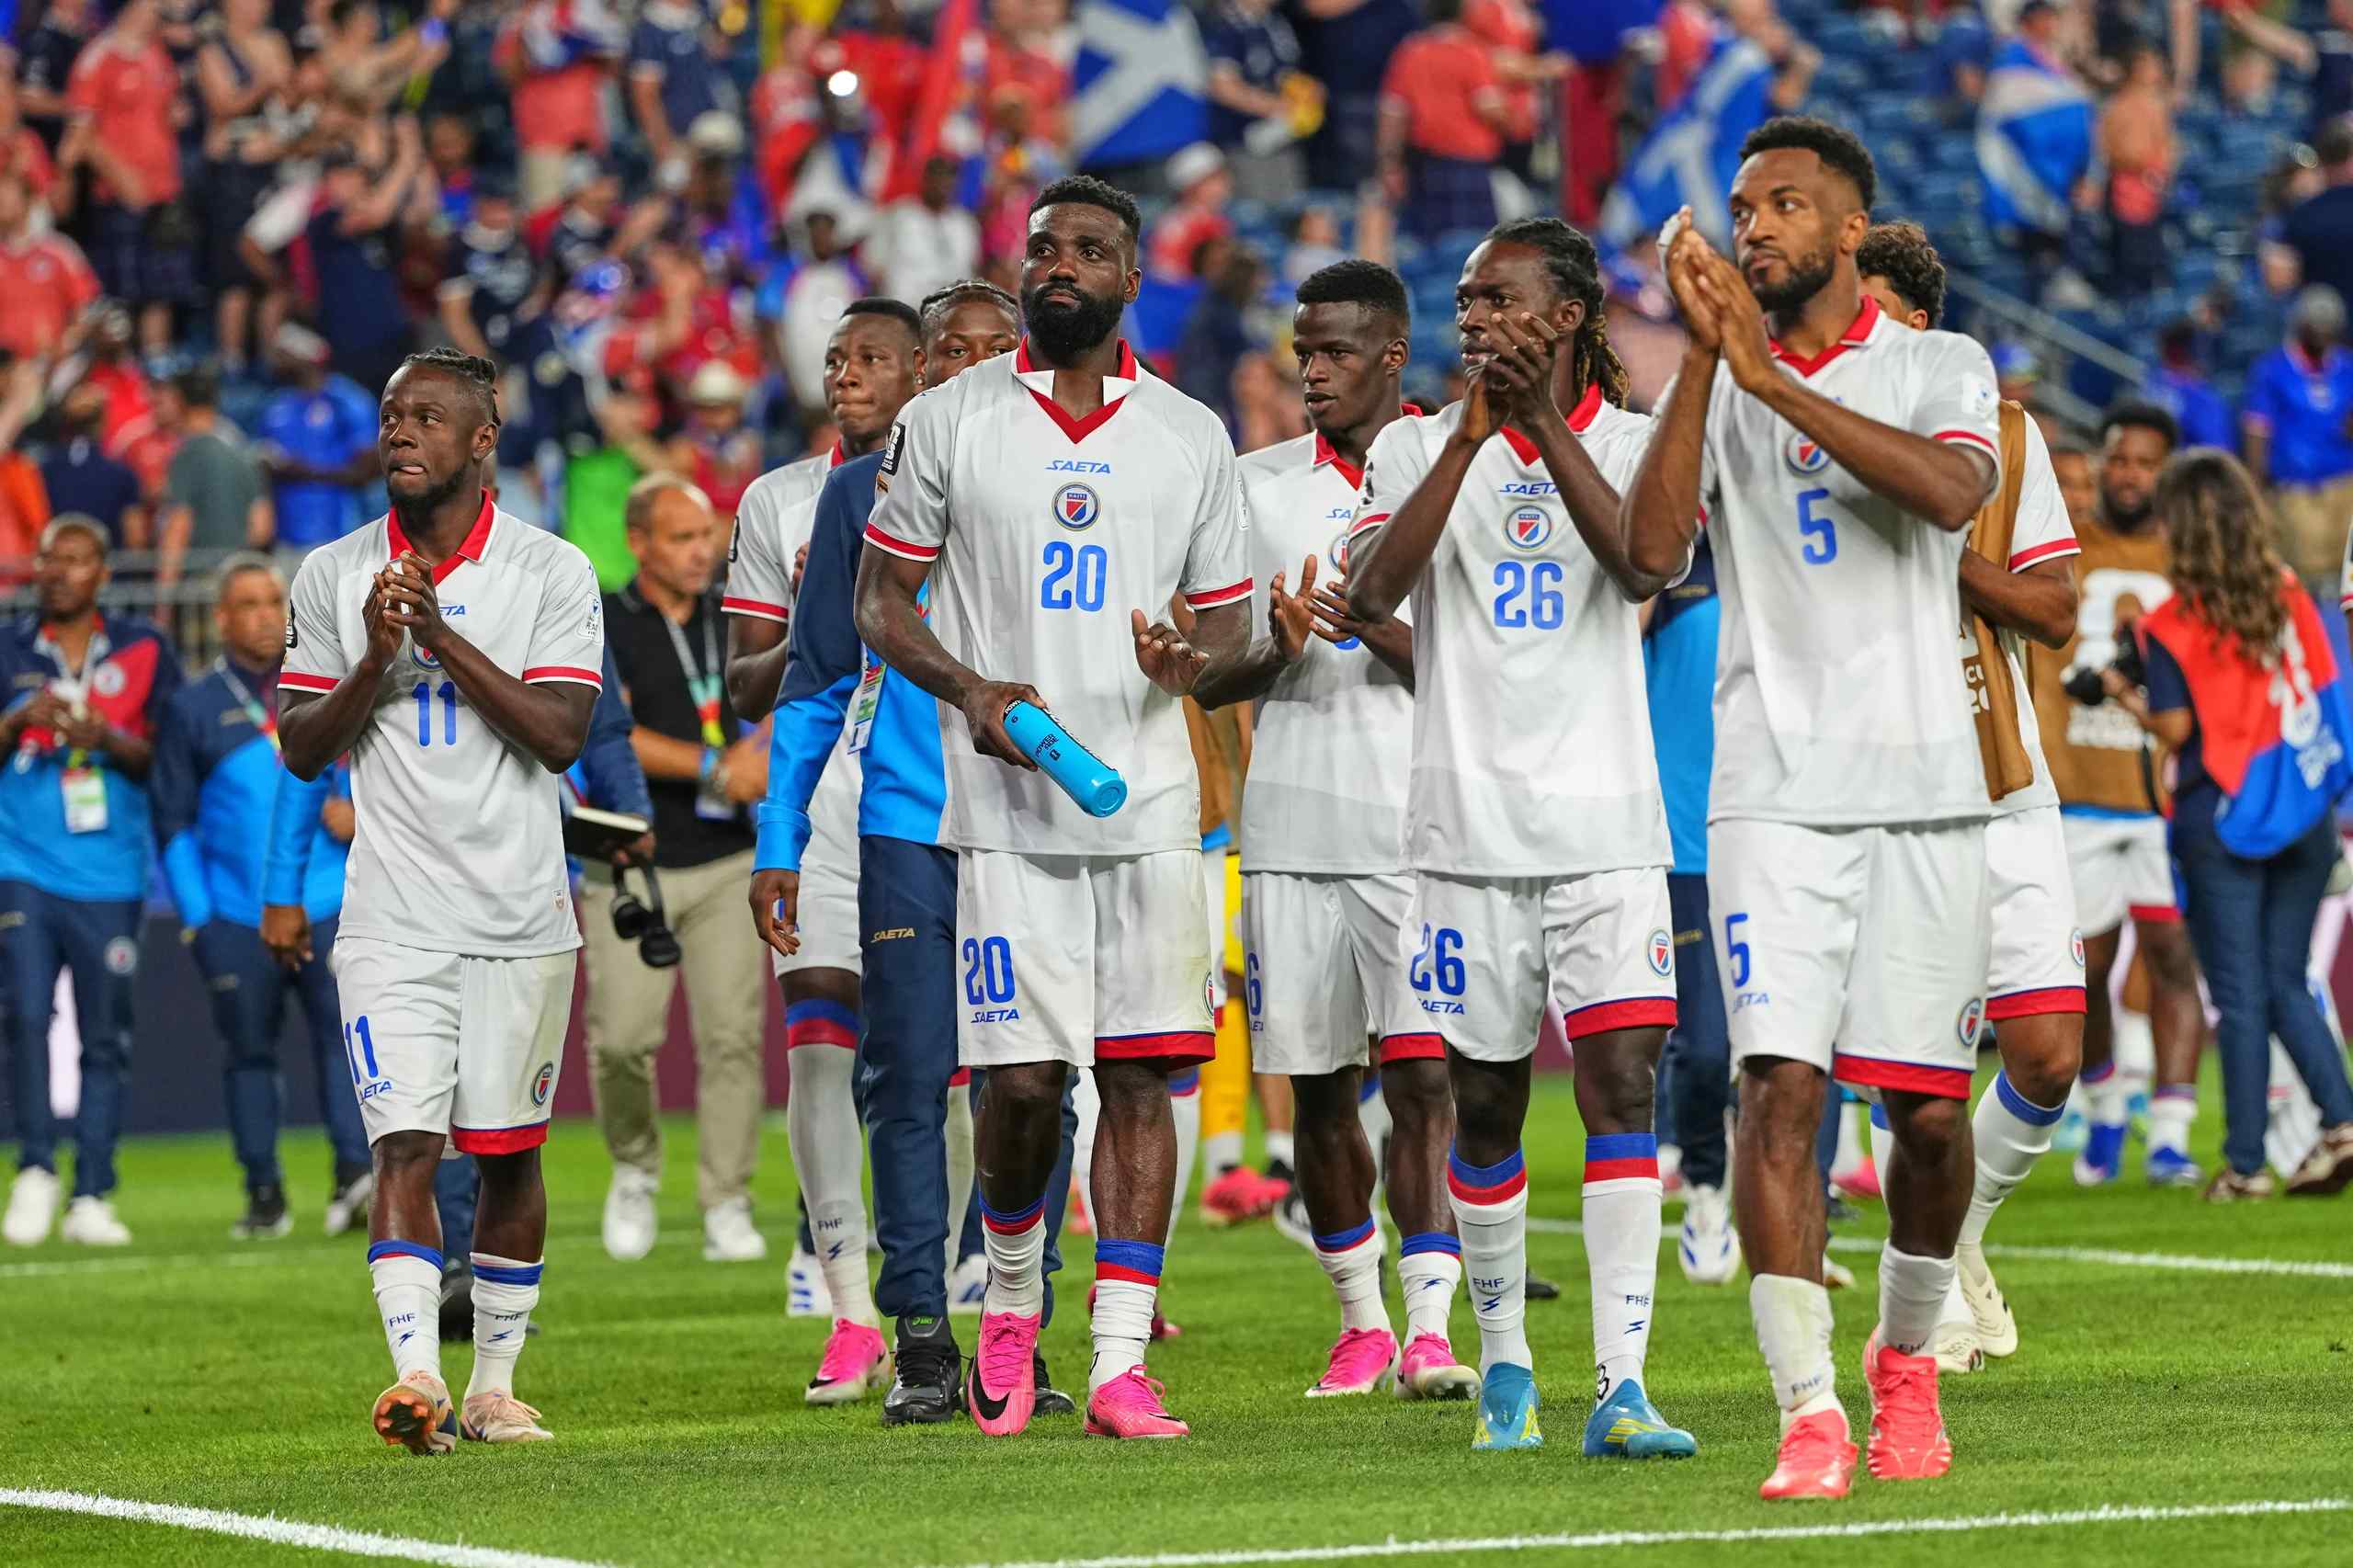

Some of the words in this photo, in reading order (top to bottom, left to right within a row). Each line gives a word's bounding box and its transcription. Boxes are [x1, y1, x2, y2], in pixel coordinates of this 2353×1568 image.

[1045, 460, 1111, 474] SAETA
[1797, 488, 1837, 565] 5
[1041, 540, 1108, 612] 20
[1494, 562, 1563, 630] 26
[412, 681, 457, 747] 11
[870, 927, 915, 943] SAETA
[1410, 922, 1466, 996] 26
[1726, 913, 1749, 988] 5
[962, 936, 1016, 1006] 20
[971, 1008, 1019, 1024] SAETA
[1419, 998, 1465, 1015] AETA
[345, 1015, 379, 1085] 11
[1472, 1277, 1505, 1288] FHF
[1626, 1294, 1651, 1307] FHF
[389, 1312, 415, 1327] FHF
